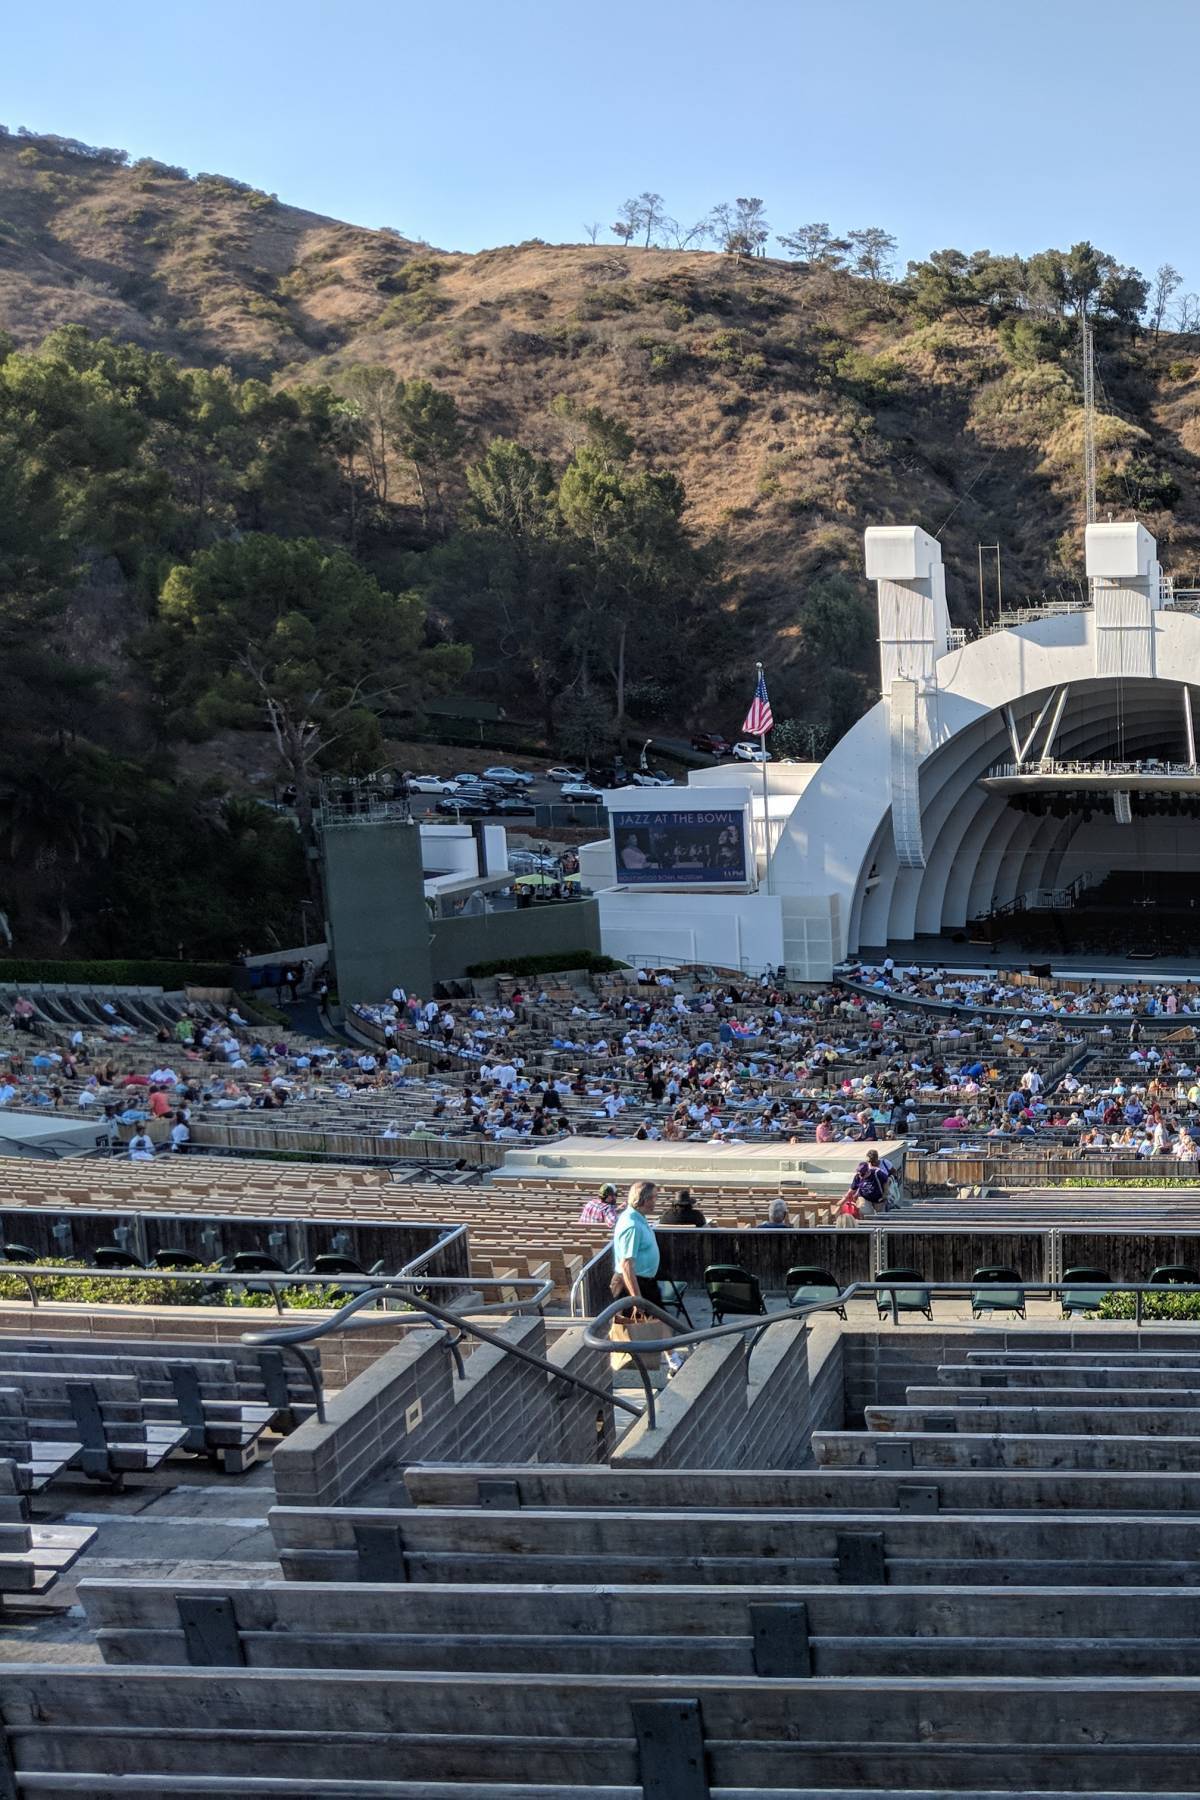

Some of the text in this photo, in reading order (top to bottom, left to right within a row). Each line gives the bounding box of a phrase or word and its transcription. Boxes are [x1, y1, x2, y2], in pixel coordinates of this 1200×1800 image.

[619, 813, 734, 826] JAZZ AT THE BOWL
[658, 874, 677, 882] BOWL
